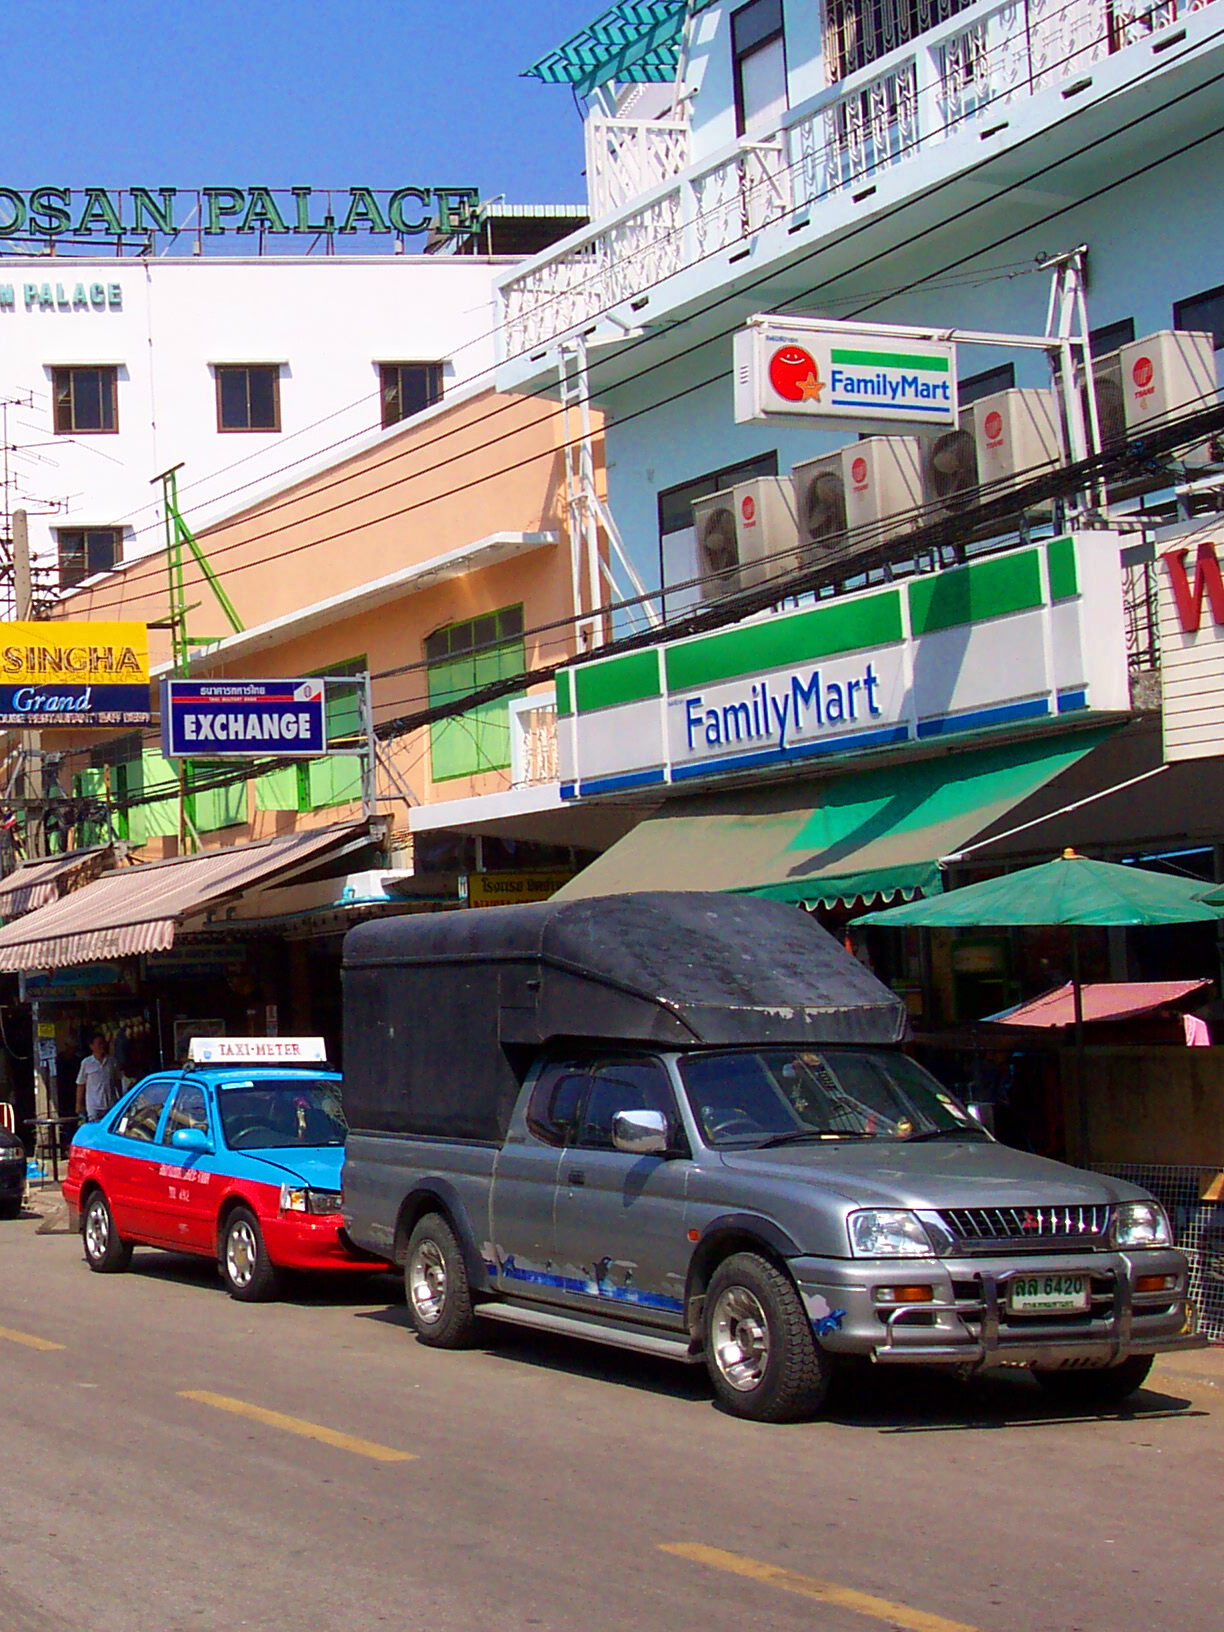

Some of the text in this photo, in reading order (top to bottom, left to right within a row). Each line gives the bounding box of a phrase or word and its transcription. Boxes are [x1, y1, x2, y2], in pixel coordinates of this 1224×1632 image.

[203, 187, 480, 235] PALACE
[24, 283, 122, 308] PALACE
[831, 369, 950, 400] FamilyMart
[2, 646, 143, 674] SINGHA
[12, 687, 92, 712] Grand
[686, 661, 880, 749] FamilyMart
[184, 714, 311, 740] EXCHANGE
[1044, 1278, 1082, 1295] 6420
